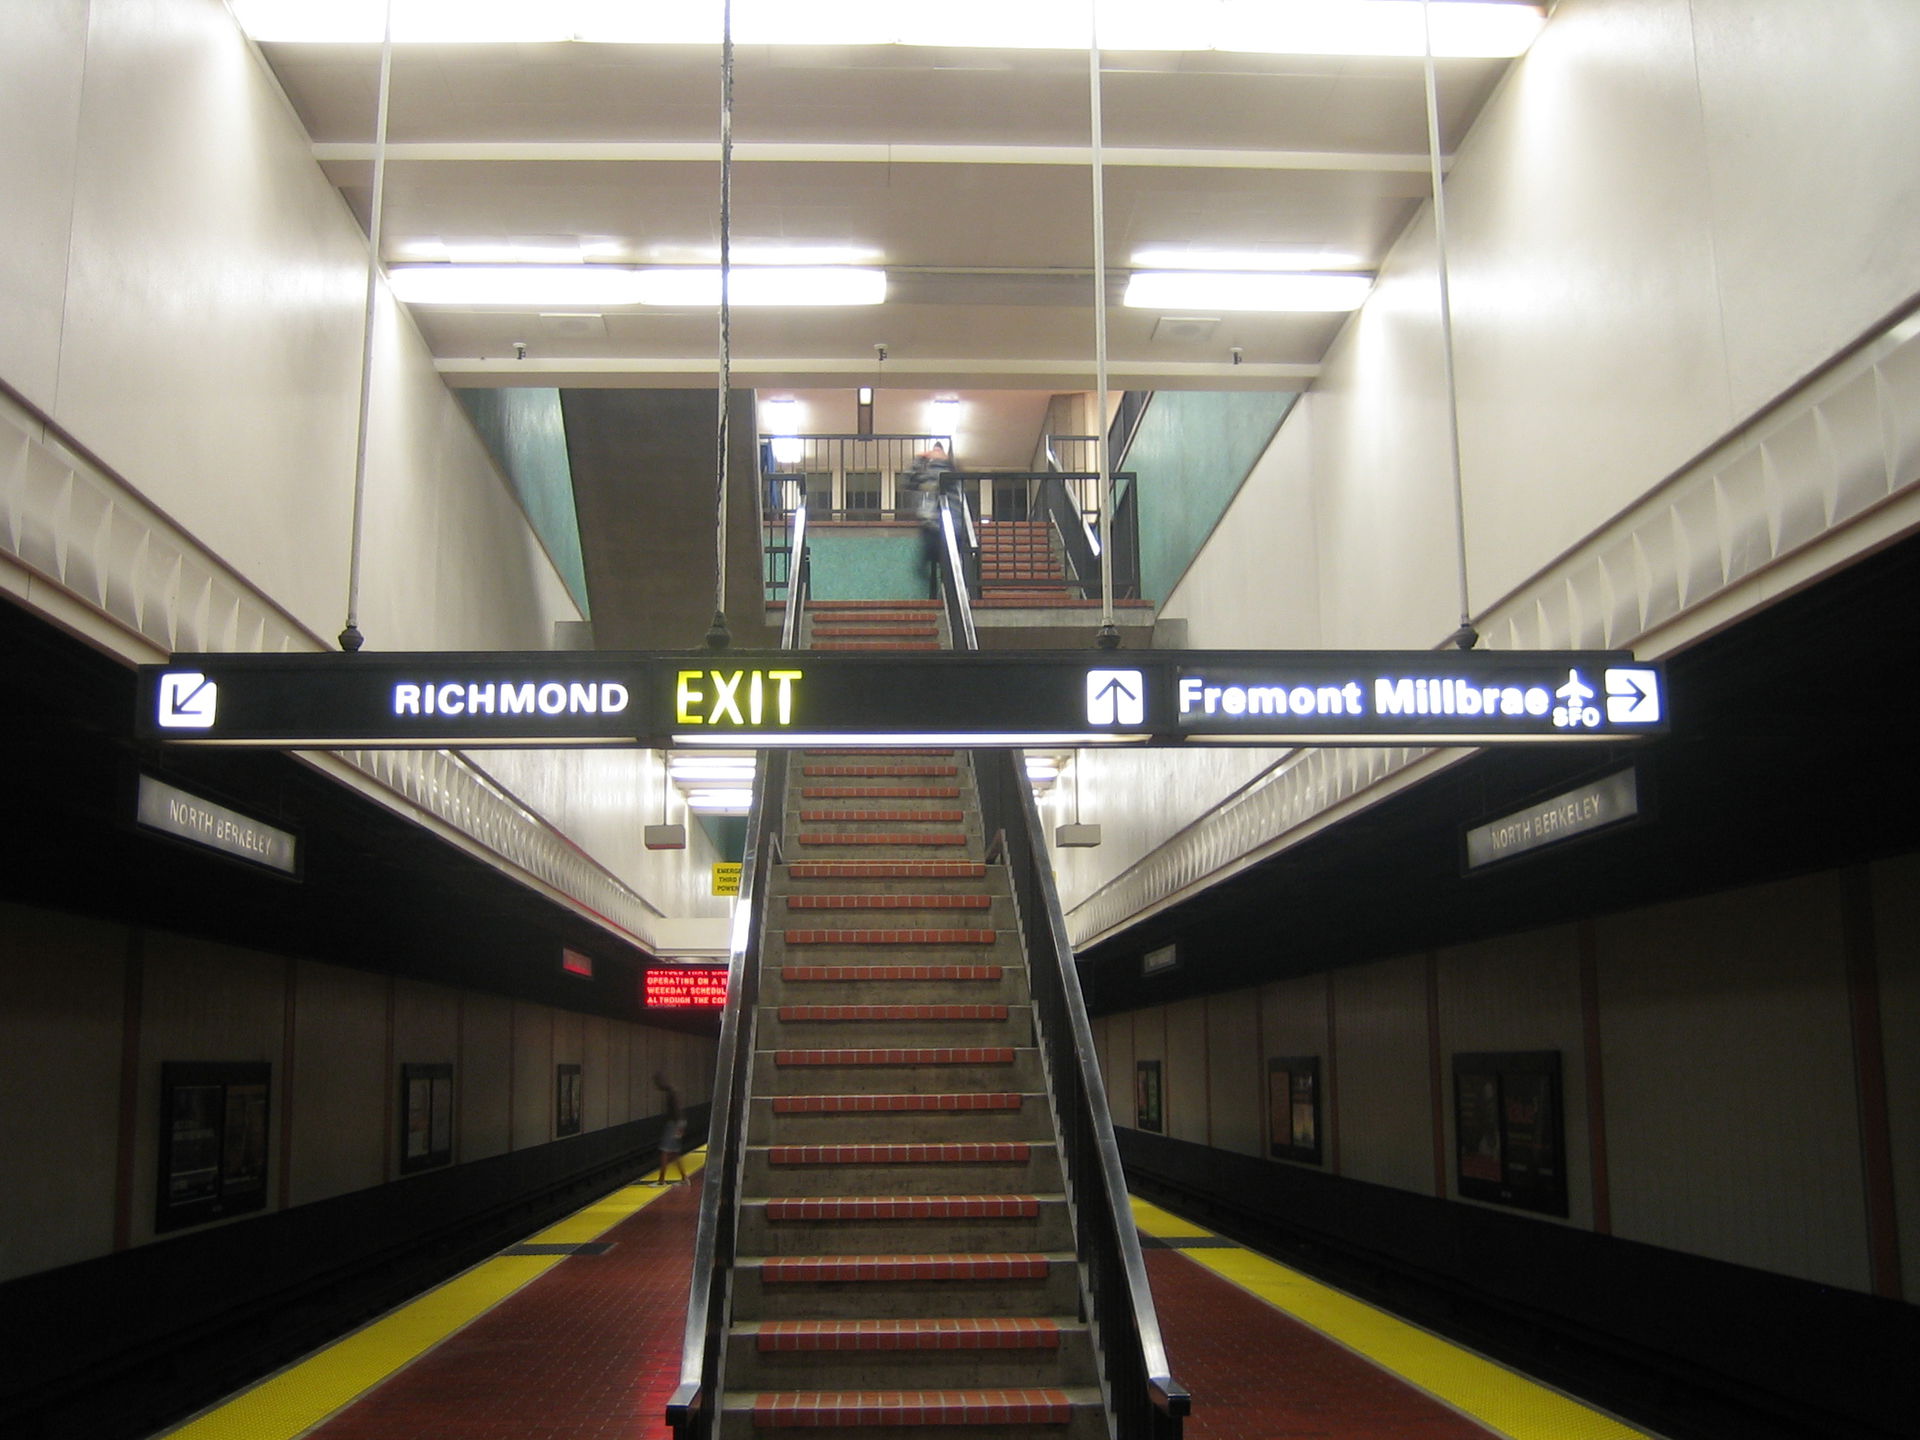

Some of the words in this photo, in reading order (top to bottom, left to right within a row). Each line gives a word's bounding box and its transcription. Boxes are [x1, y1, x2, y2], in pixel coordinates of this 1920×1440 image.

[394, 682, 630, 715] RICHMOND
[677, 669, 803, 725] EXIT
[1178, 678, 1363, 715] Fremont
[1374, 678, 1550, 716] Millbrae
[1552, 705, 1601, 728] SFO
[169, 799, 214, 834] NORTH
[216, 819, 272, 856] BERKELEY
[1491, 820, 1532, 850] NORTH
[1534, 793, 1601, 837] BERKELEY
[646, 977, 695, 985] OPERATING
[646, 987, 688, 995] WEEKDAY
[646, 996, 691, 1004] ALTHOUGH
[693, 996, 709, 1004] THE
